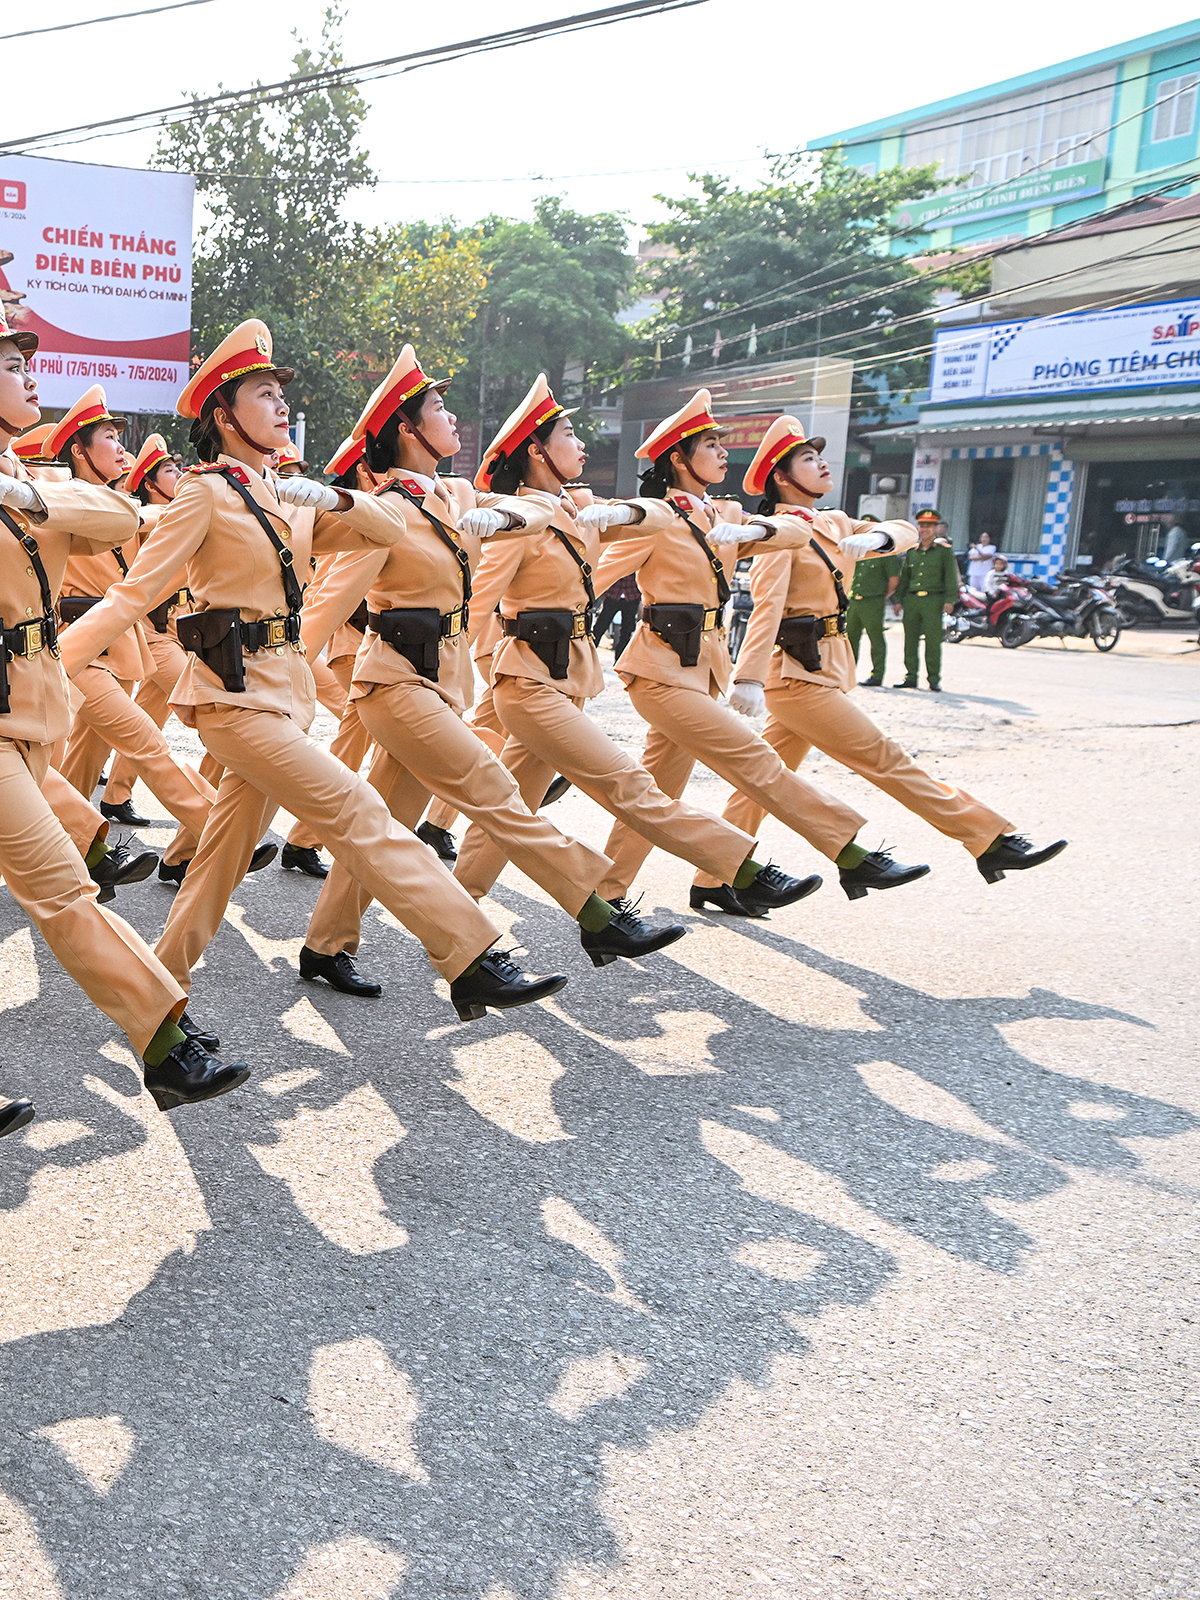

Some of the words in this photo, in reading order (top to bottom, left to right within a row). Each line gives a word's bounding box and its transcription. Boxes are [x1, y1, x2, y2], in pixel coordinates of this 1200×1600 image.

[42, 224, 104, 248] CHIẾN
[109, 230, 177, 256] THẮNG
[35, 253, 84, 277] ĐIỆN
[90, 258, 136, 280] BIÊN
[142, 263, 182, 283] PHỦ
[165, 291, 188, 302] MINH
[40, 355, 63, 375] PHỦ
[66, 360, 118, 378] (7/5/1954
[128, 365, 178, 383] 7/5/2024)
[1033, 356, 1102, 380] PHÒNG
[1108, 350, 1159, 374] TIÊM
